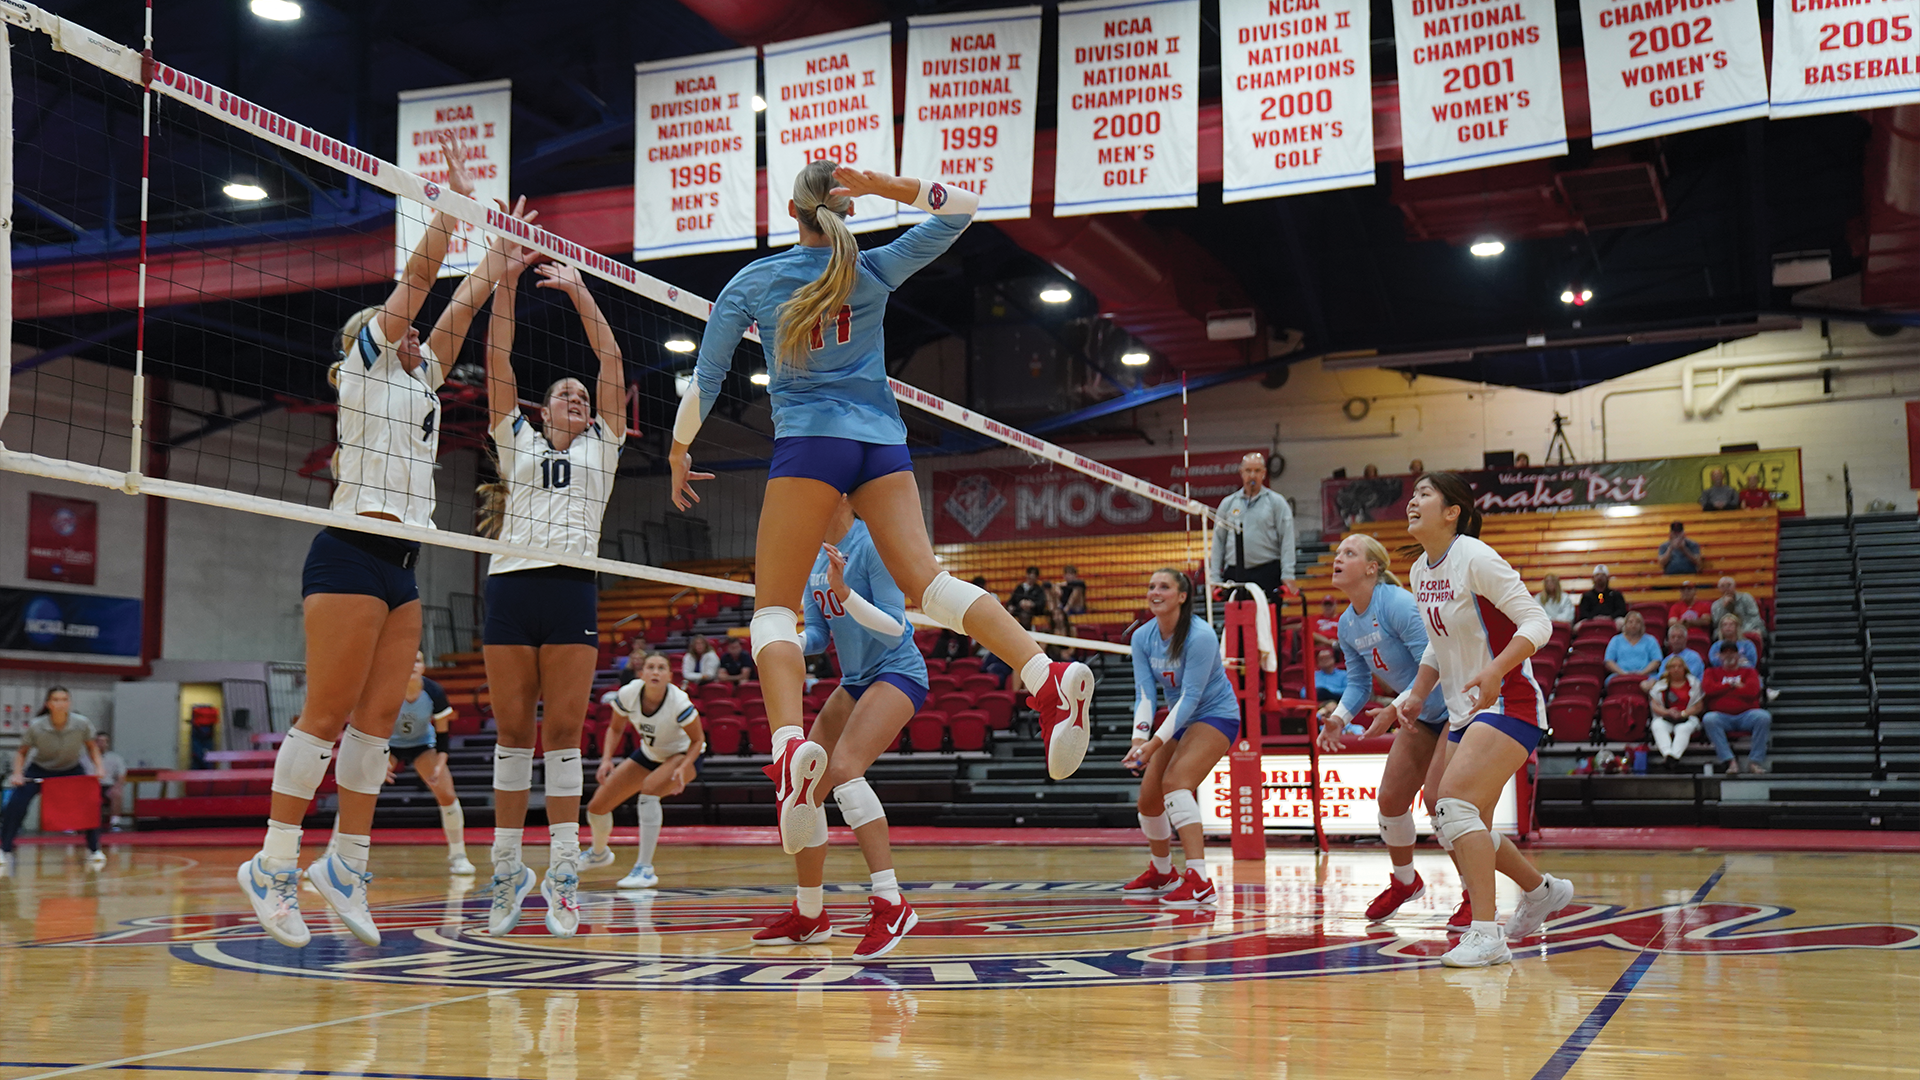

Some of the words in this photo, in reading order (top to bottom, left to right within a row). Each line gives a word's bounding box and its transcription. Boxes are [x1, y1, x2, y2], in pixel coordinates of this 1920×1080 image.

[1269, 0, 1320, 16] NCAA
[1424, 3, 1525, 38] NATIONAL
[1104, 17, 1152, 38] NCAA
[1239, 15, 1327, 44] DIVISION
[1334, 11, 1350, 29] II
[1629, 16, 1713, 58] 2002
[1820, 15, 1912, 51] 2005
[951, 33, 996, 53] NCAA
[1075, 39, 1158, 64] DIVISION
[1166, 36, 1180, 54] II
[1248, 37, 1342, 66] NATIONAL
[1413, 26, 1540, 65] CHAMPIONS
[806, 54, 849, 75] NCAA
[923, 55, 1000, 76] DIVISION
[1007, 54, 1022, 70] II
[1084, 62, 1171, 86] NATIONAL
[1237, 59, 1354, 91] CHAMPIONS
[1443, 57, 1514, 93] 2001
[1621, 50, 1728, 88] WOMEN'S
[675, 76, 717, 95] NCAA
[781, 74, 855, 101] DIVISION
[862, 70, 875, 87] II
[930, 77, 1012, 98] NATIONAL
[1072, 84, 1182, 110] CHAMPIONS
[1650, 80, 1705, 108] GOLF
[435, 105, 474, 123] NCAA
[651, 97, 721, 120] DIVISION
[728, 93, 739, 109] II
[790, 94, 867, 122] NATIONAL
[918, 99, 1022, 121] CHAMPIONS
[1260, 89, 1332, 121] 2000
[1432, 90, 1530, 123] WOMEN'S
[153, 62, 213, 105] LORIDA
[220, 91, 296, 142] SOUTHERN
[300, 127, 379, 177] MOCCASINS
[658, 116, 733, 140] NATIONAL
[780, 114, 880, 145] CHAMPIONS
[1093, 111, 1160, 140] 2000
[1458, 118, 1509, 143] GOLF
[941, 125, 998, 151] 1999
[1252, 121, 1343, 148] WOMEN'S
[418, 145, 489, 166] NATNAL
[648, 136, 742, 162] CHAMPIONS
[1098, 144, 1154, 164] MEN'S
[1275, 147, 1322, 169] GOLF
[670, 163, 721, 188] 1996
[941, 157, 993, 175] MEN'S
[1104, 167, 1148, 187] GOLF
[671, 192, 719, 211] MEN'S
[677, 214, 714, 232] GOLF
[534, 227, 582, 263] SOUTHERN
[540, 458, 571, 489] 10
[1015, 478, 1153, 530] MOCS
[1471, 480, 1573, 510] nake
[1588, 475, 1647, 502] Pit
[1420, 579, 1450, 591] FORIDA
[813, 588, 846, 620] 20
[1427, 607, 1449, 637] 14
[1372, 647, 1388, 671] 4
[1162, 671, 1176, 687] 7
[1214, 770, 1341, 784] FORIDA
[1214, 787, 1377, 801] SUTHERN
[1215, 804, 1350, 818] CLEGE
[1239, 785, 1254, 835] senoh
[324, 950, 1119, 983] FLORIDA
